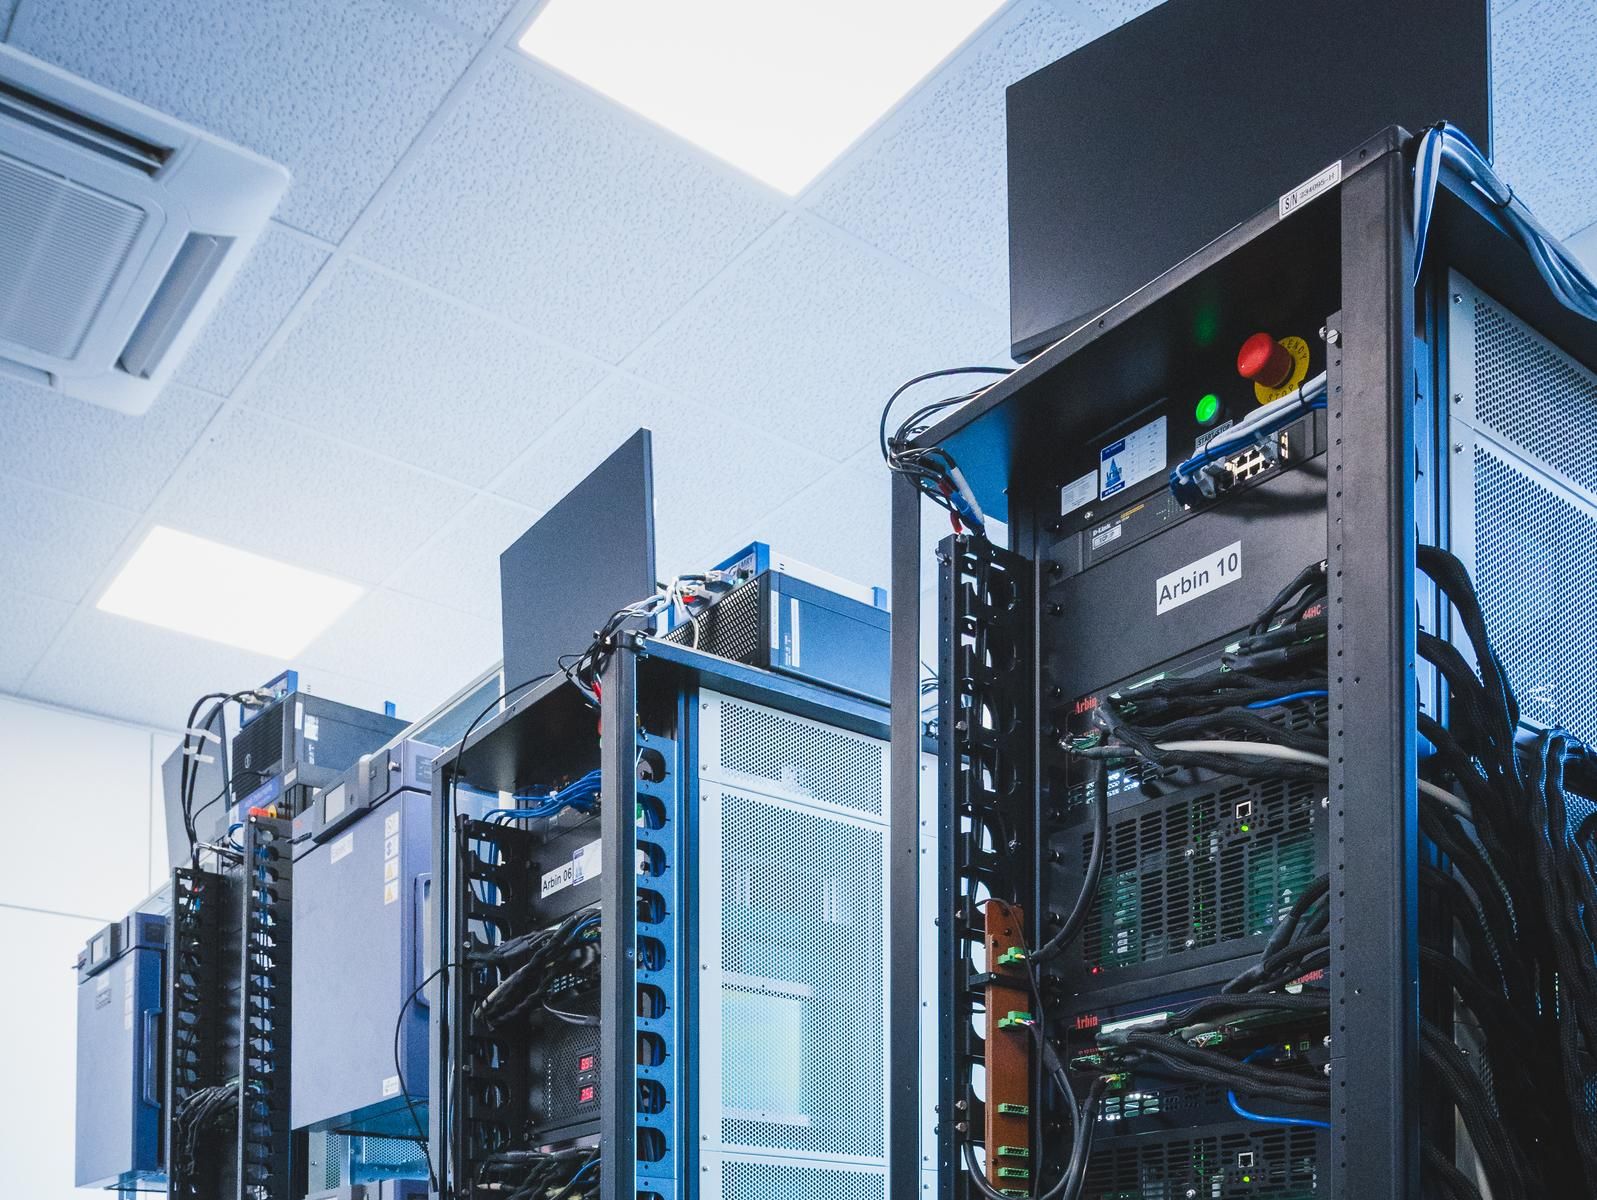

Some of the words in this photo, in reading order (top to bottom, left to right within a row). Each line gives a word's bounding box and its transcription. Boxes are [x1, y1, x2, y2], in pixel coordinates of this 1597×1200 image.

[1159, 570, 1209, 606] Arbin
[1217, 552, 1238, 577] 10
[1074, 696, 1097, 715] Arbin
[543, 873, 562, 892] Arbin
[563, 867, 572, 882] 06
[1075, 1014, 1098, 1030] Arbin
